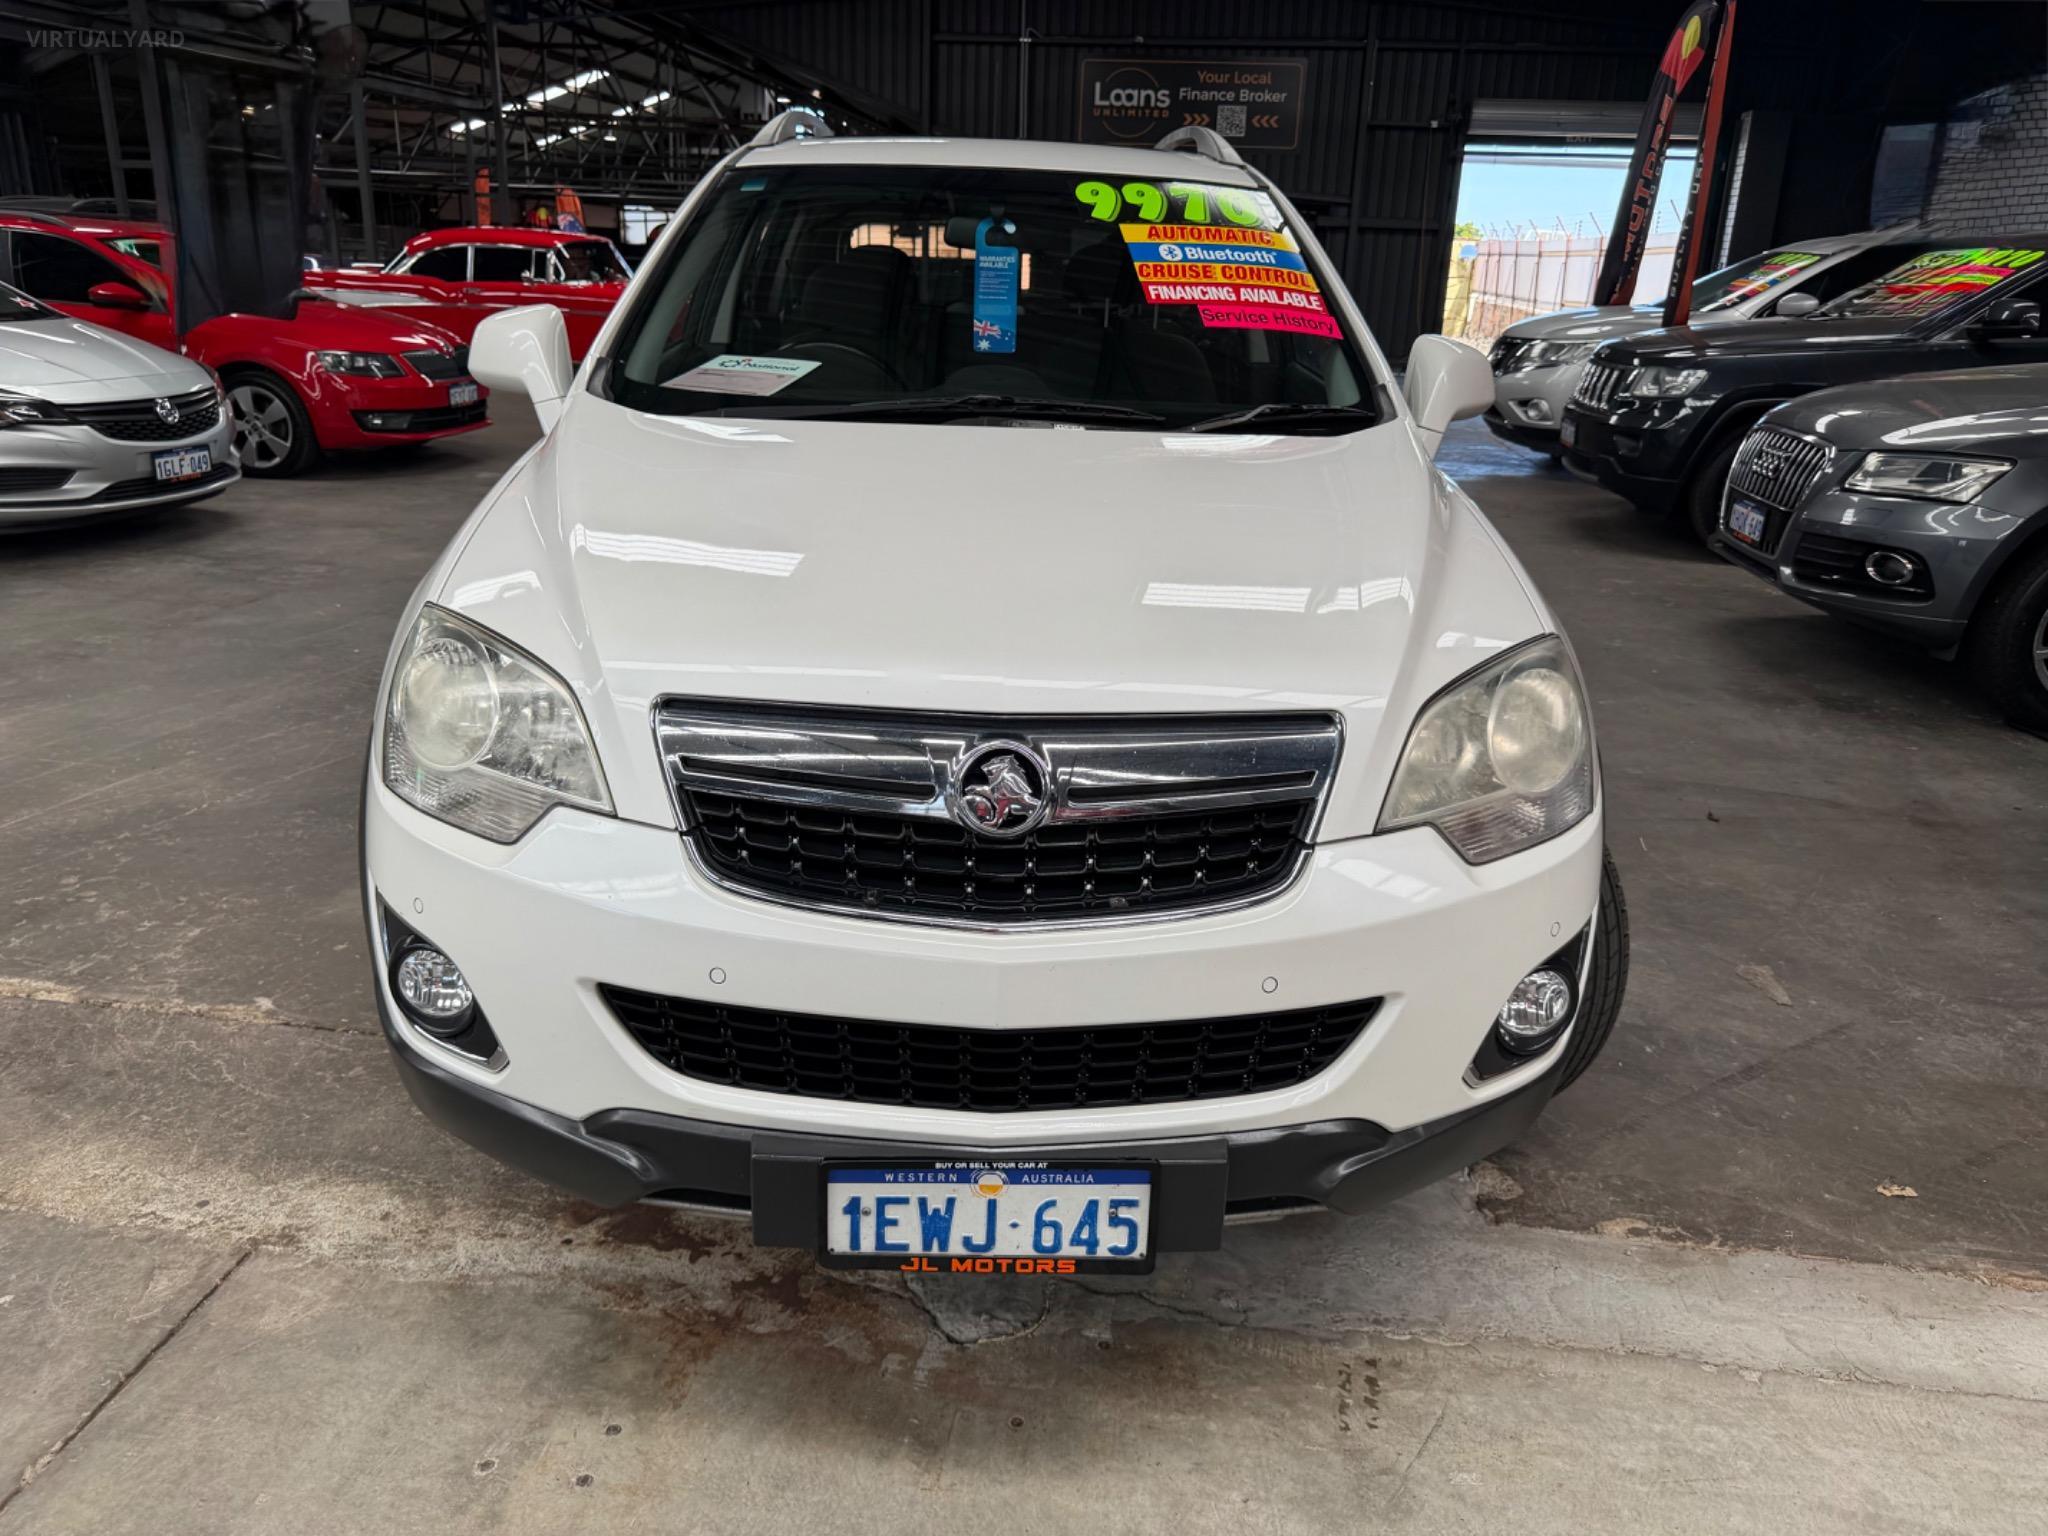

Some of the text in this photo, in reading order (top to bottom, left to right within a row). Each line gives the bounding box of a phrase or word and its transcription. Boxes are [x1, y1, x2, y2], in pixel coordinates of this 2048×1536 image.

[1198, 71, 1272, 85] Your Local
[1094, 81, 1171, 108] Loans
[1179, 88, 1288, 103] Finance Broker
[1093, 108, 1170, 118] UNLIMITED
[1075, 181, 1266, 227] 9970
[1147, 225, 1274, 246] AUTOMATIC
[1184, 246, 1277, 264] Bluetooth
[1138, 263, 1311, 288] CRUISE CONTROL
[1148, 285, 1323, 311] FINANCING AVAILABLE
[1202, 308, 1335, 335] Service History
[885, 1172, 1095, 1184] WESTERN AUSTRALIA
[901, 1257, 1077, 1273] JL MOTORS
